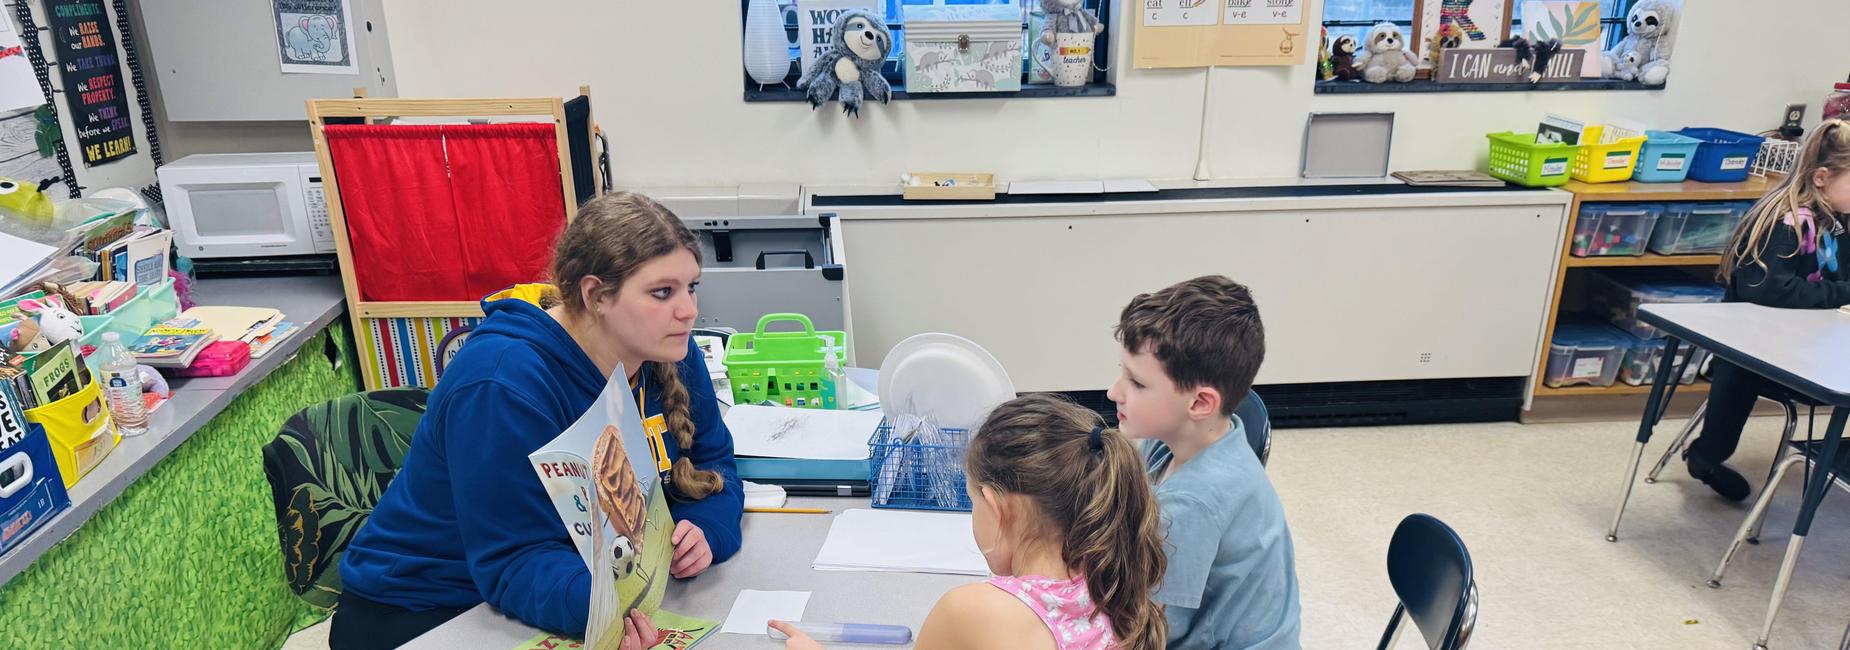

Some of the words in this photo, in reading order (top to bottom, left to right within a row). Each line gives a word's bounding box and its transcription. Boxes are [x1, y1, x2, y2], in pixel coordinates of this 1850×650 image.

[68, 26, 79, 36] We
[79, 21, 99, 35] RAISE
[71, 42, 82, 50] our
[66, 61, 78, 73] We
[78, 57, 95, 70] TAKE
[1449, 53, 1460, 79] I
[1462, 53, 1493, 79] CAN
[77, 82, 89, 93] We
[88, 74, 115, 91] RESPECT
[88, 112, 100, 123] We
[98, 106, 118, 119] THINK
[77, 125, 102, 139] before
[102, 126, 112, 134] we
[86, 143, 103, 162] WE
[103, 136, 132, 158] LEARN!
[43, 358, 70, 388] FROGS
[573, 494, 588, 513] &
